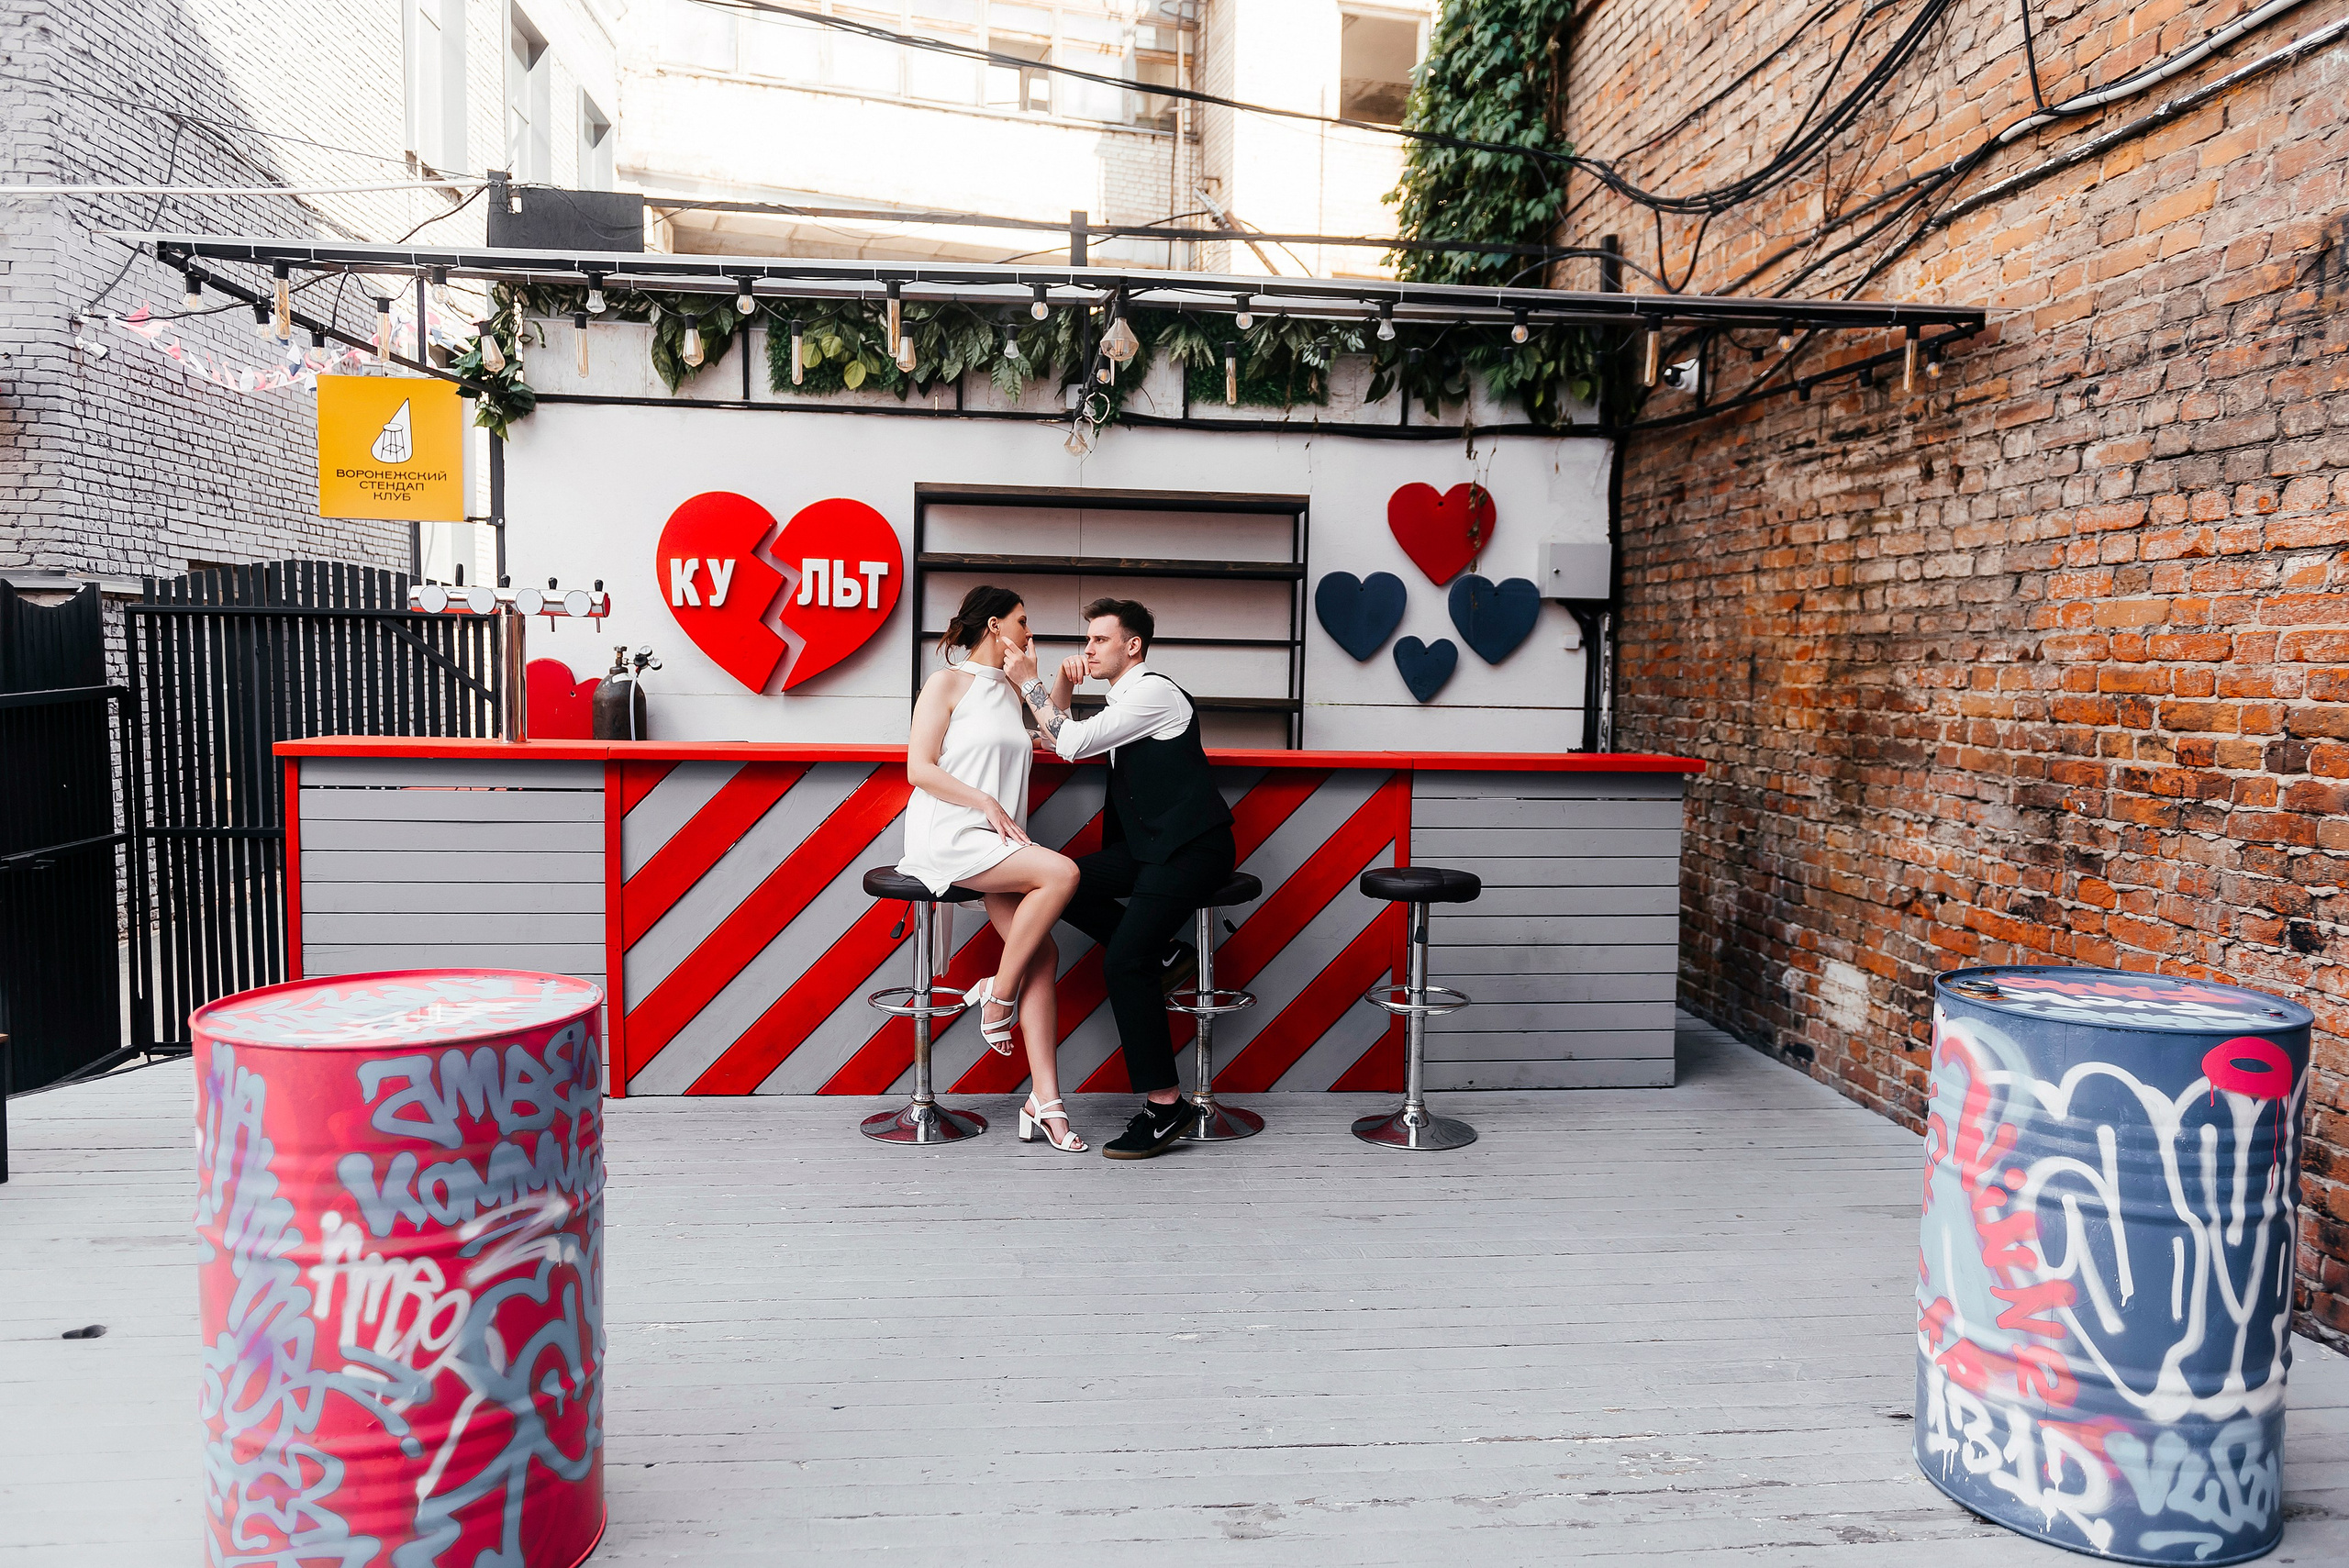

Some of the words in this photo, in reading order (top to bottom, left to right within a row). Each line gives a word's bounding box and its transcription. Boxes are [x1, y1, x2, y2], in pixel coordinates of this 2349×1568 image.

[336, 469, 447, 481] ВОРОНЕЖСКИЙ
[359, 481, 425, 492] СТЕНДАП
[373, 492, 411, 502] КЛУБ
